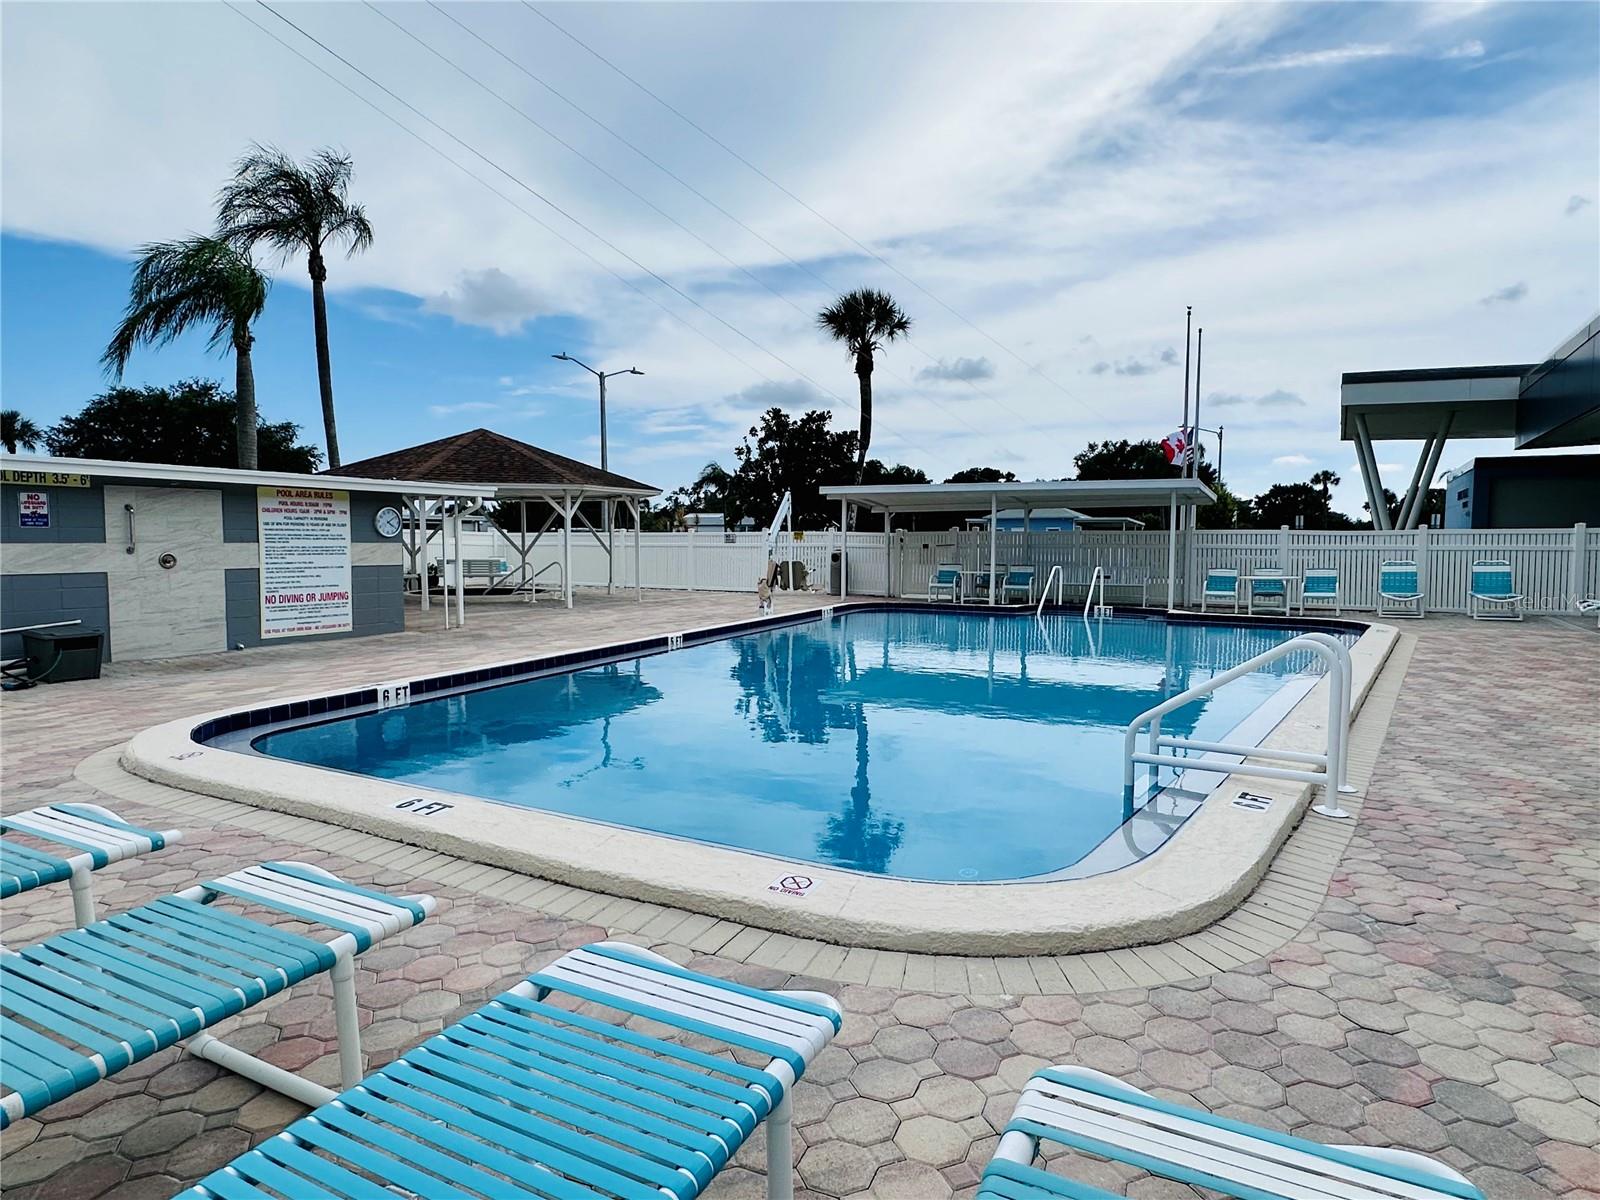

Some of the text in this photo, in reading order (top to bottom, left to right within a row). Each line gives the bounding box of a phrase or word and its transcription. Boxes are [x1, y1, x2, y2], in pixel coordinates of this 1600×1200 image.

[13, 471, 47, 483] DEPTH
[276, 489, 334, 499] POOL AREA RULES
[265, 591, 349, 605] NO DIVING OR JUMPING
[382, 685, 409, 701] 6 FT
[395, 798, 455, 816] 6 FT
[780, 888, 806, 897] DIVING
